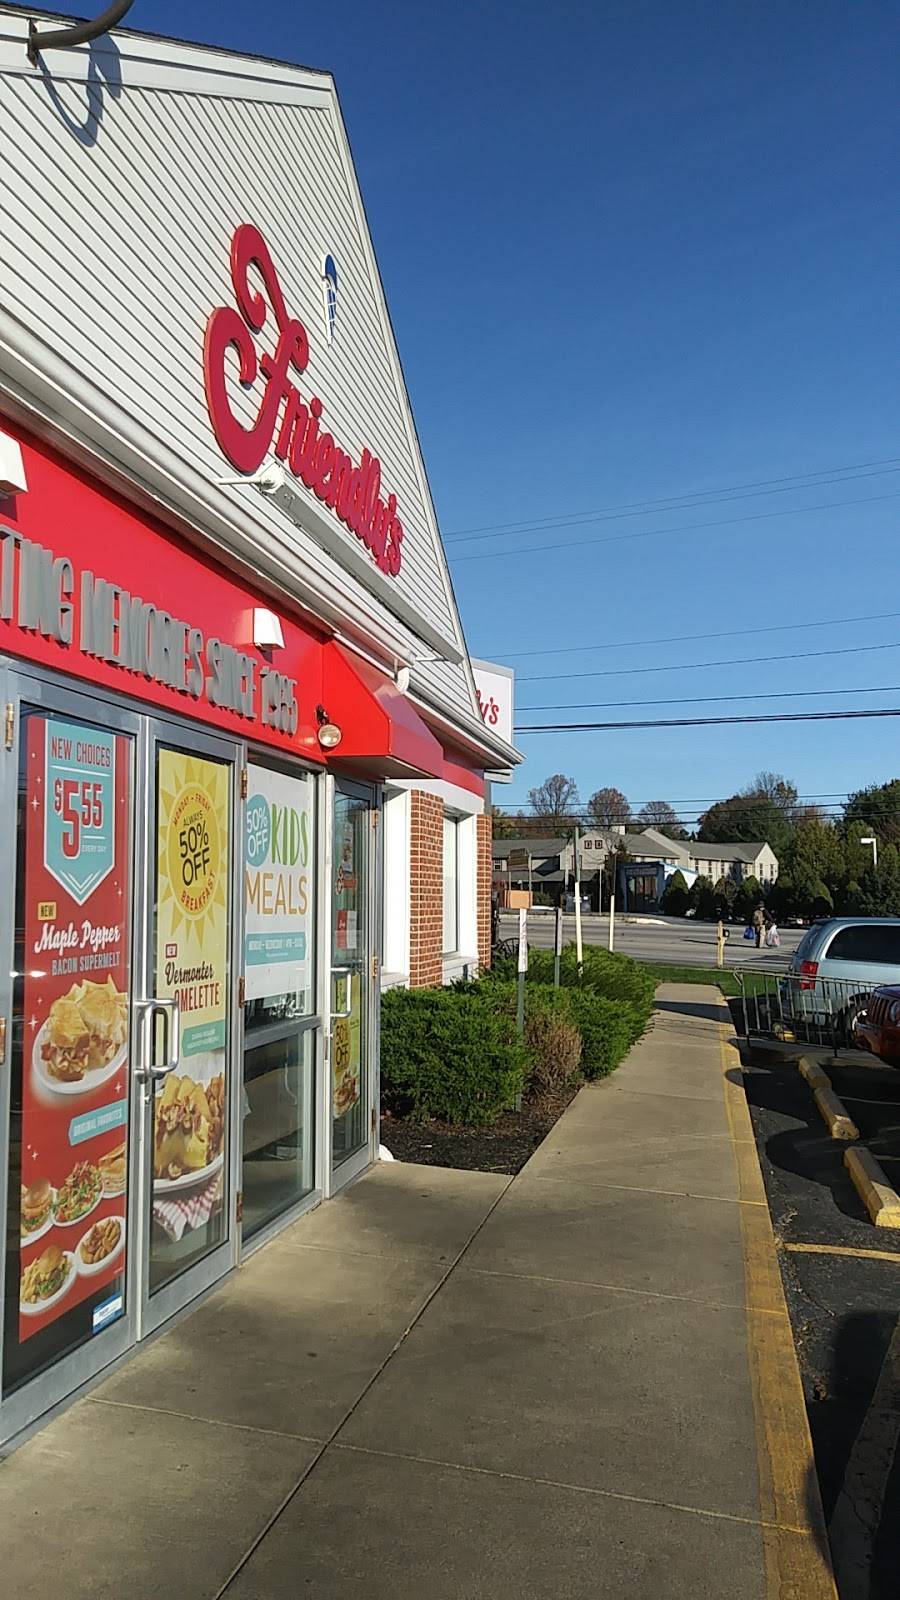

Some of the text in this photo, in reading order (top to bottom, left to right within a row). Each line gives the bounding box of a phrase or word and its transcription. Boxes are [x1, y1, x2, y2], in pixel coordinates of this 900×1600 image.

[203, 223, 403, 577] Friendly's
[80, 569, 204, 699] MEMORIES
[205, 637, 258, 721] SINCE
[260, 666, 299, 736] 1935
[51, 735, 111, 768] NEW CHOICES
[172, 796, 190, 827] MONDAY
[183, 809, 203, 826] ALWAYS
[246, 806, 268, 834] 50%
[179, 820, 209, 858] 50%
[247, 828, 269, 858] OFF
[271, 803, 308, 868] KIDS
[182, 847, 210, 887] OFF
[180, 869, 216, 912] BREAKFAST
[245, 870, 308, 916] MEALS
[40, 904, 55, 918] NEW
[34, 919, 121, 956] Maple Pepper
[52, 951, 121, 976] BACON SUPERMELT
[165, 961, 214, 986] Vermonter
[174, 982, 220, 1012] OMELETTE
